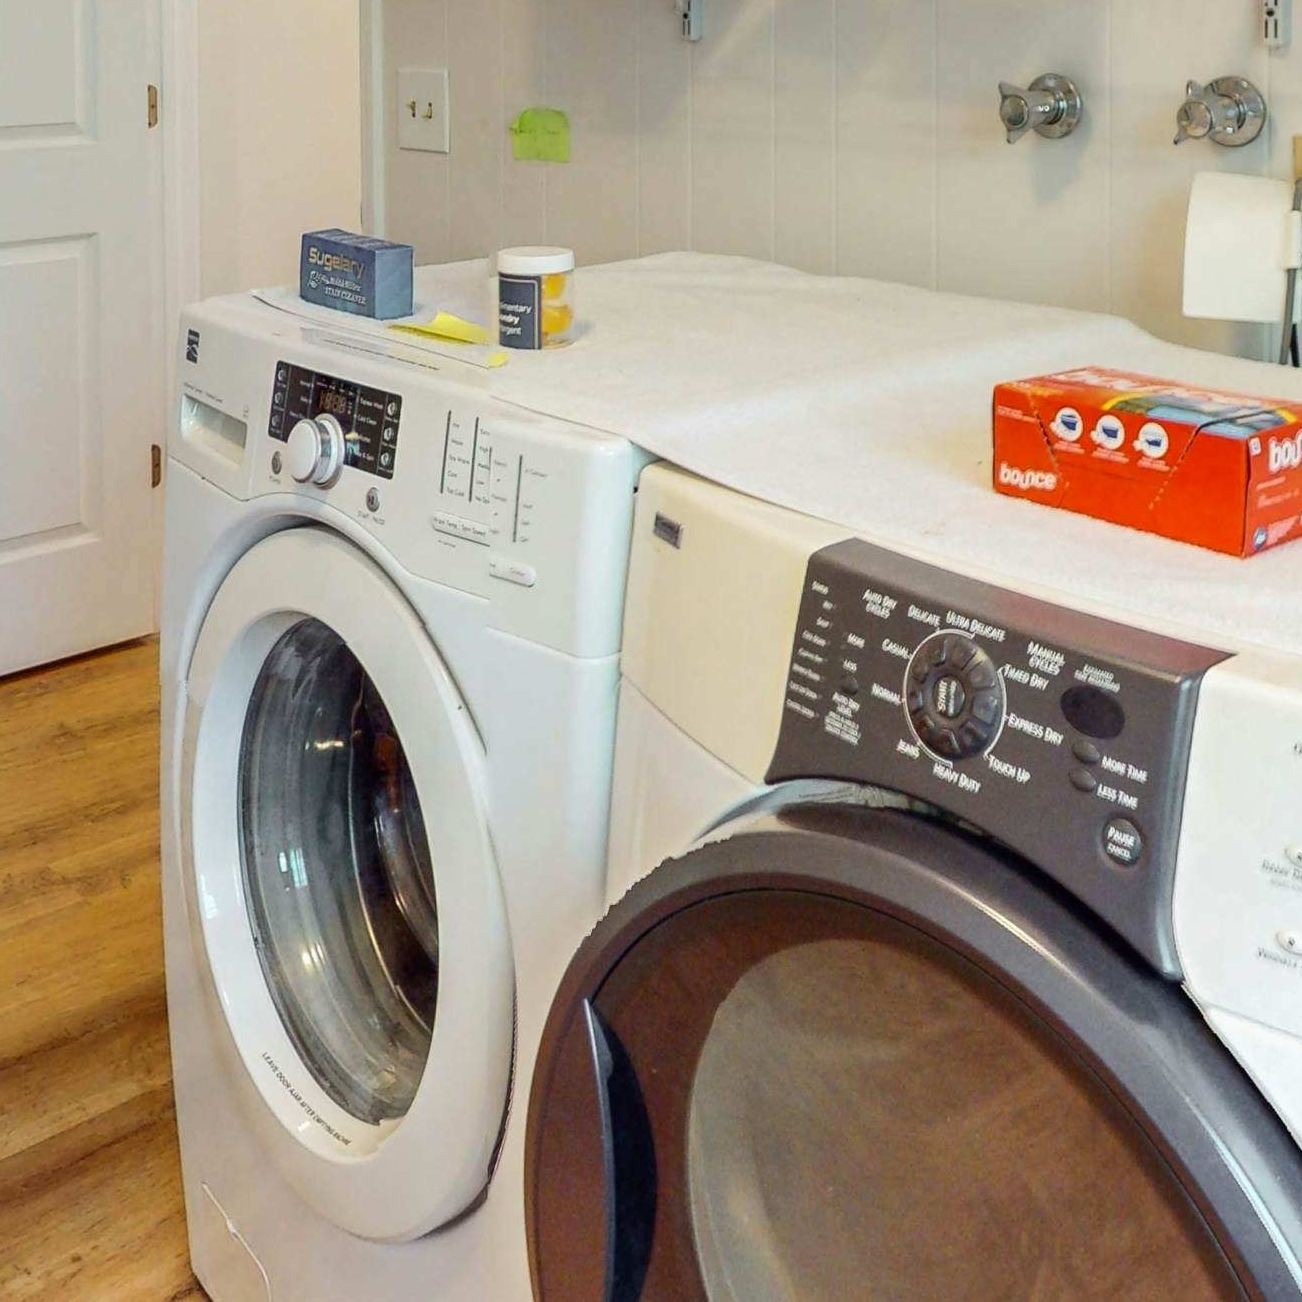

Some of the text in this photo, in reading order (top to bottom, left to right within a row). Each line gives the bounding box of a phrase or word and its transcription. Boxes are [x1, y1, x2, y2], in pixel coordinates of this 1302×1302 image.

[1000, 462, 1058, 490] bounce
[1029, 673, 1049, 690] DRY
[1007, 712, 1064, 747] EXPRESS DRY
[933, 761, 981, 794] HEAVY DUTY
[988, 754, 1031, 784] TOUCH UP
[1101, 755, 1148, 785] MORE TIME
[1097, 783, 1139, 811] LESS TIME
[1107, 825, 1135, 849] PAUSE
[276, 1071, 291, 1089] DOOR
